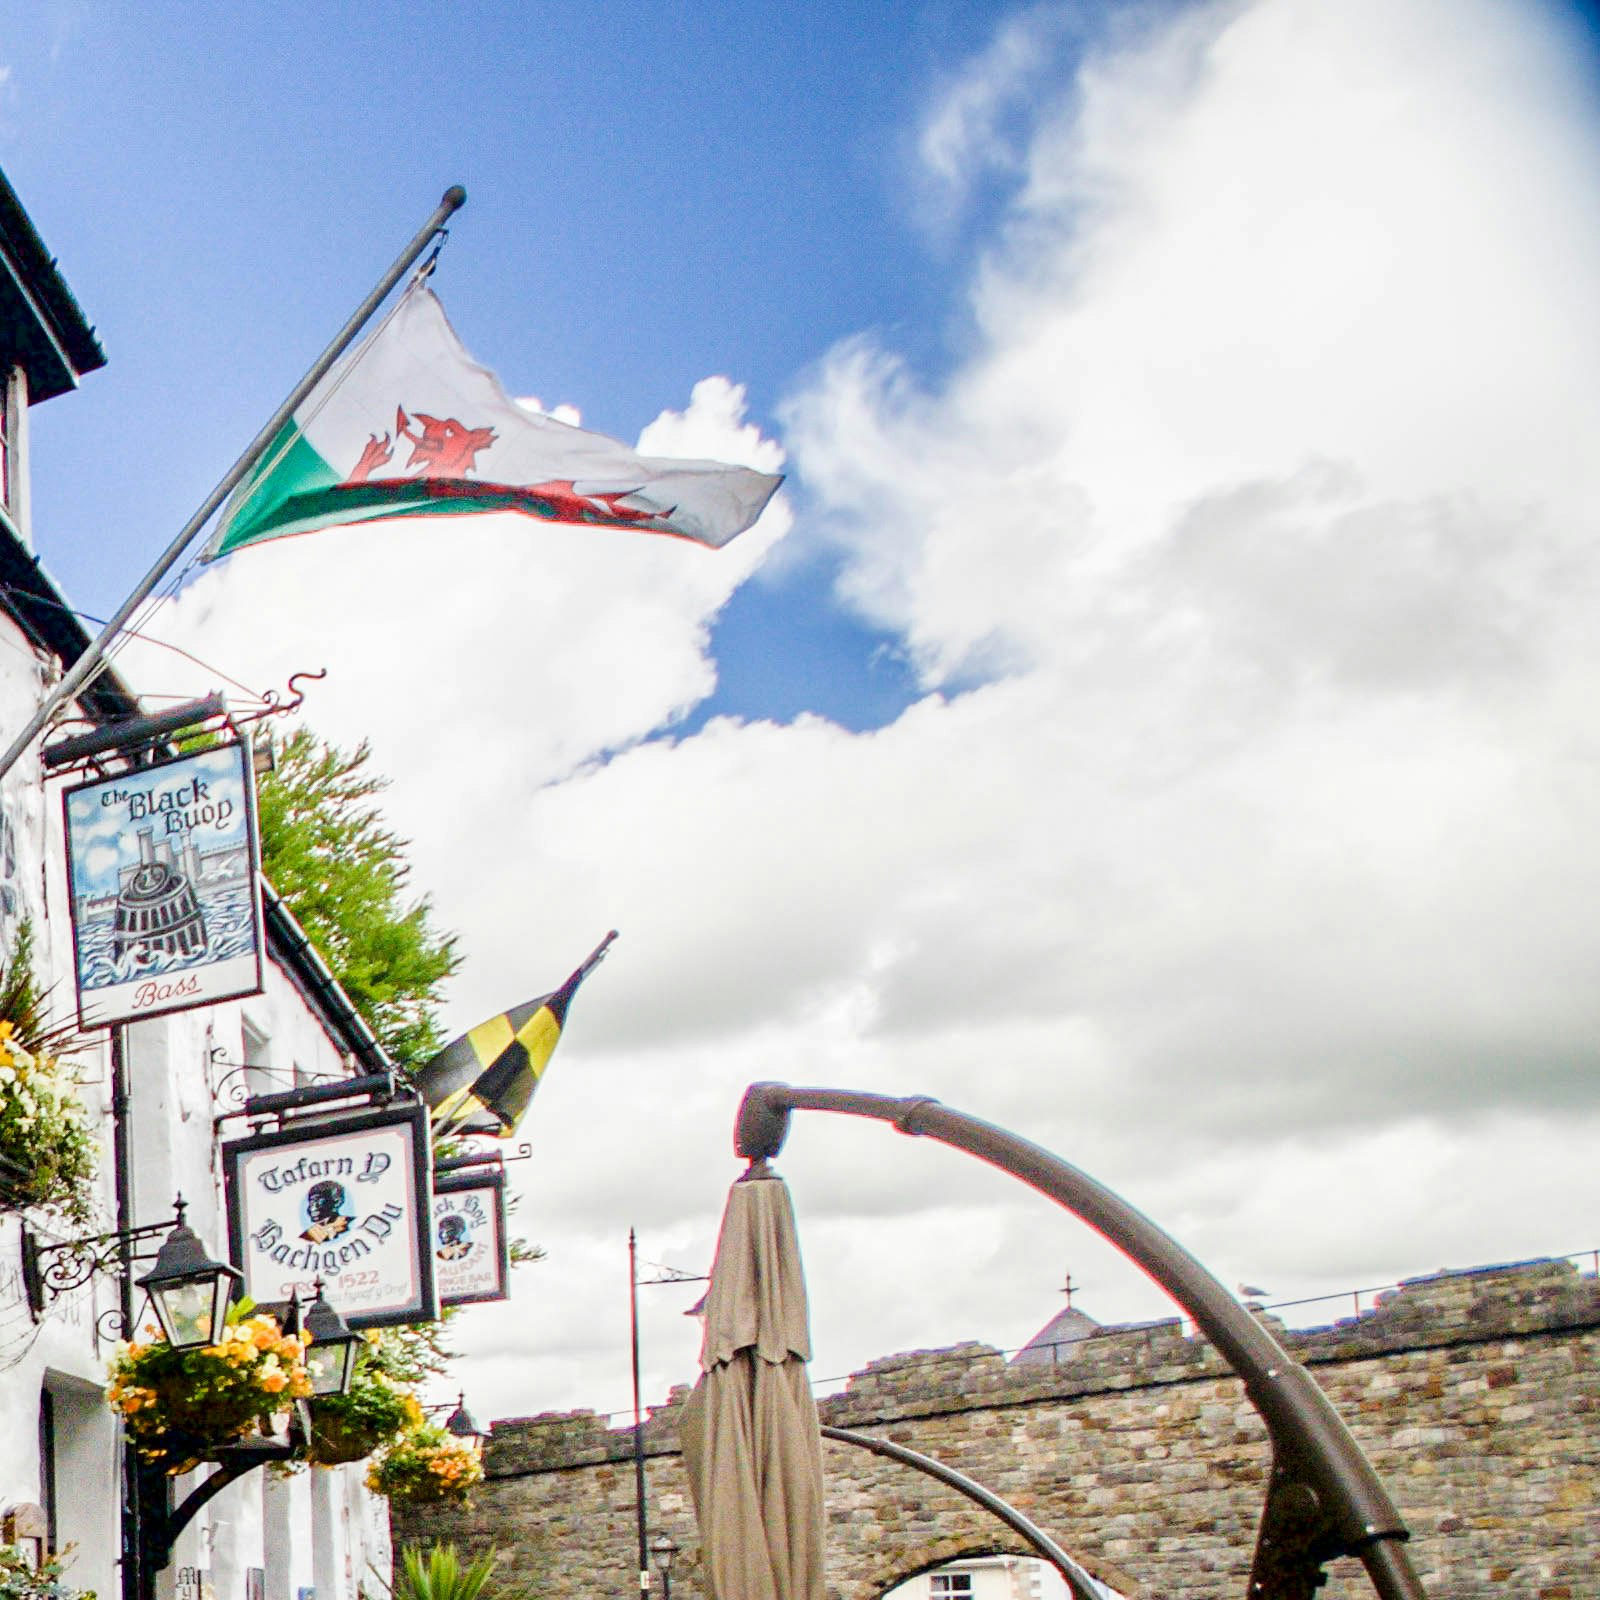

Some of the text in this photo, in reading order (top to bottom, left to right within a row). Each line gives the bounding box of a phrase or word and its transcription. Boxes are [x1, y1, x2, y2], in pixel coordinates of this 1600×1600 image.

[101, 777, 210, 822] The Black
[162, 798, 233, 835] Buoy
[132, 974, 202, 1009] Bass
[258, 1156, 353, 1193] Tafarn
[251, 1203, 403, 1276] Bachgen Du
[280, 1278, 329, 1297] CRC
[337, 1270, 380, 1290] 1522
